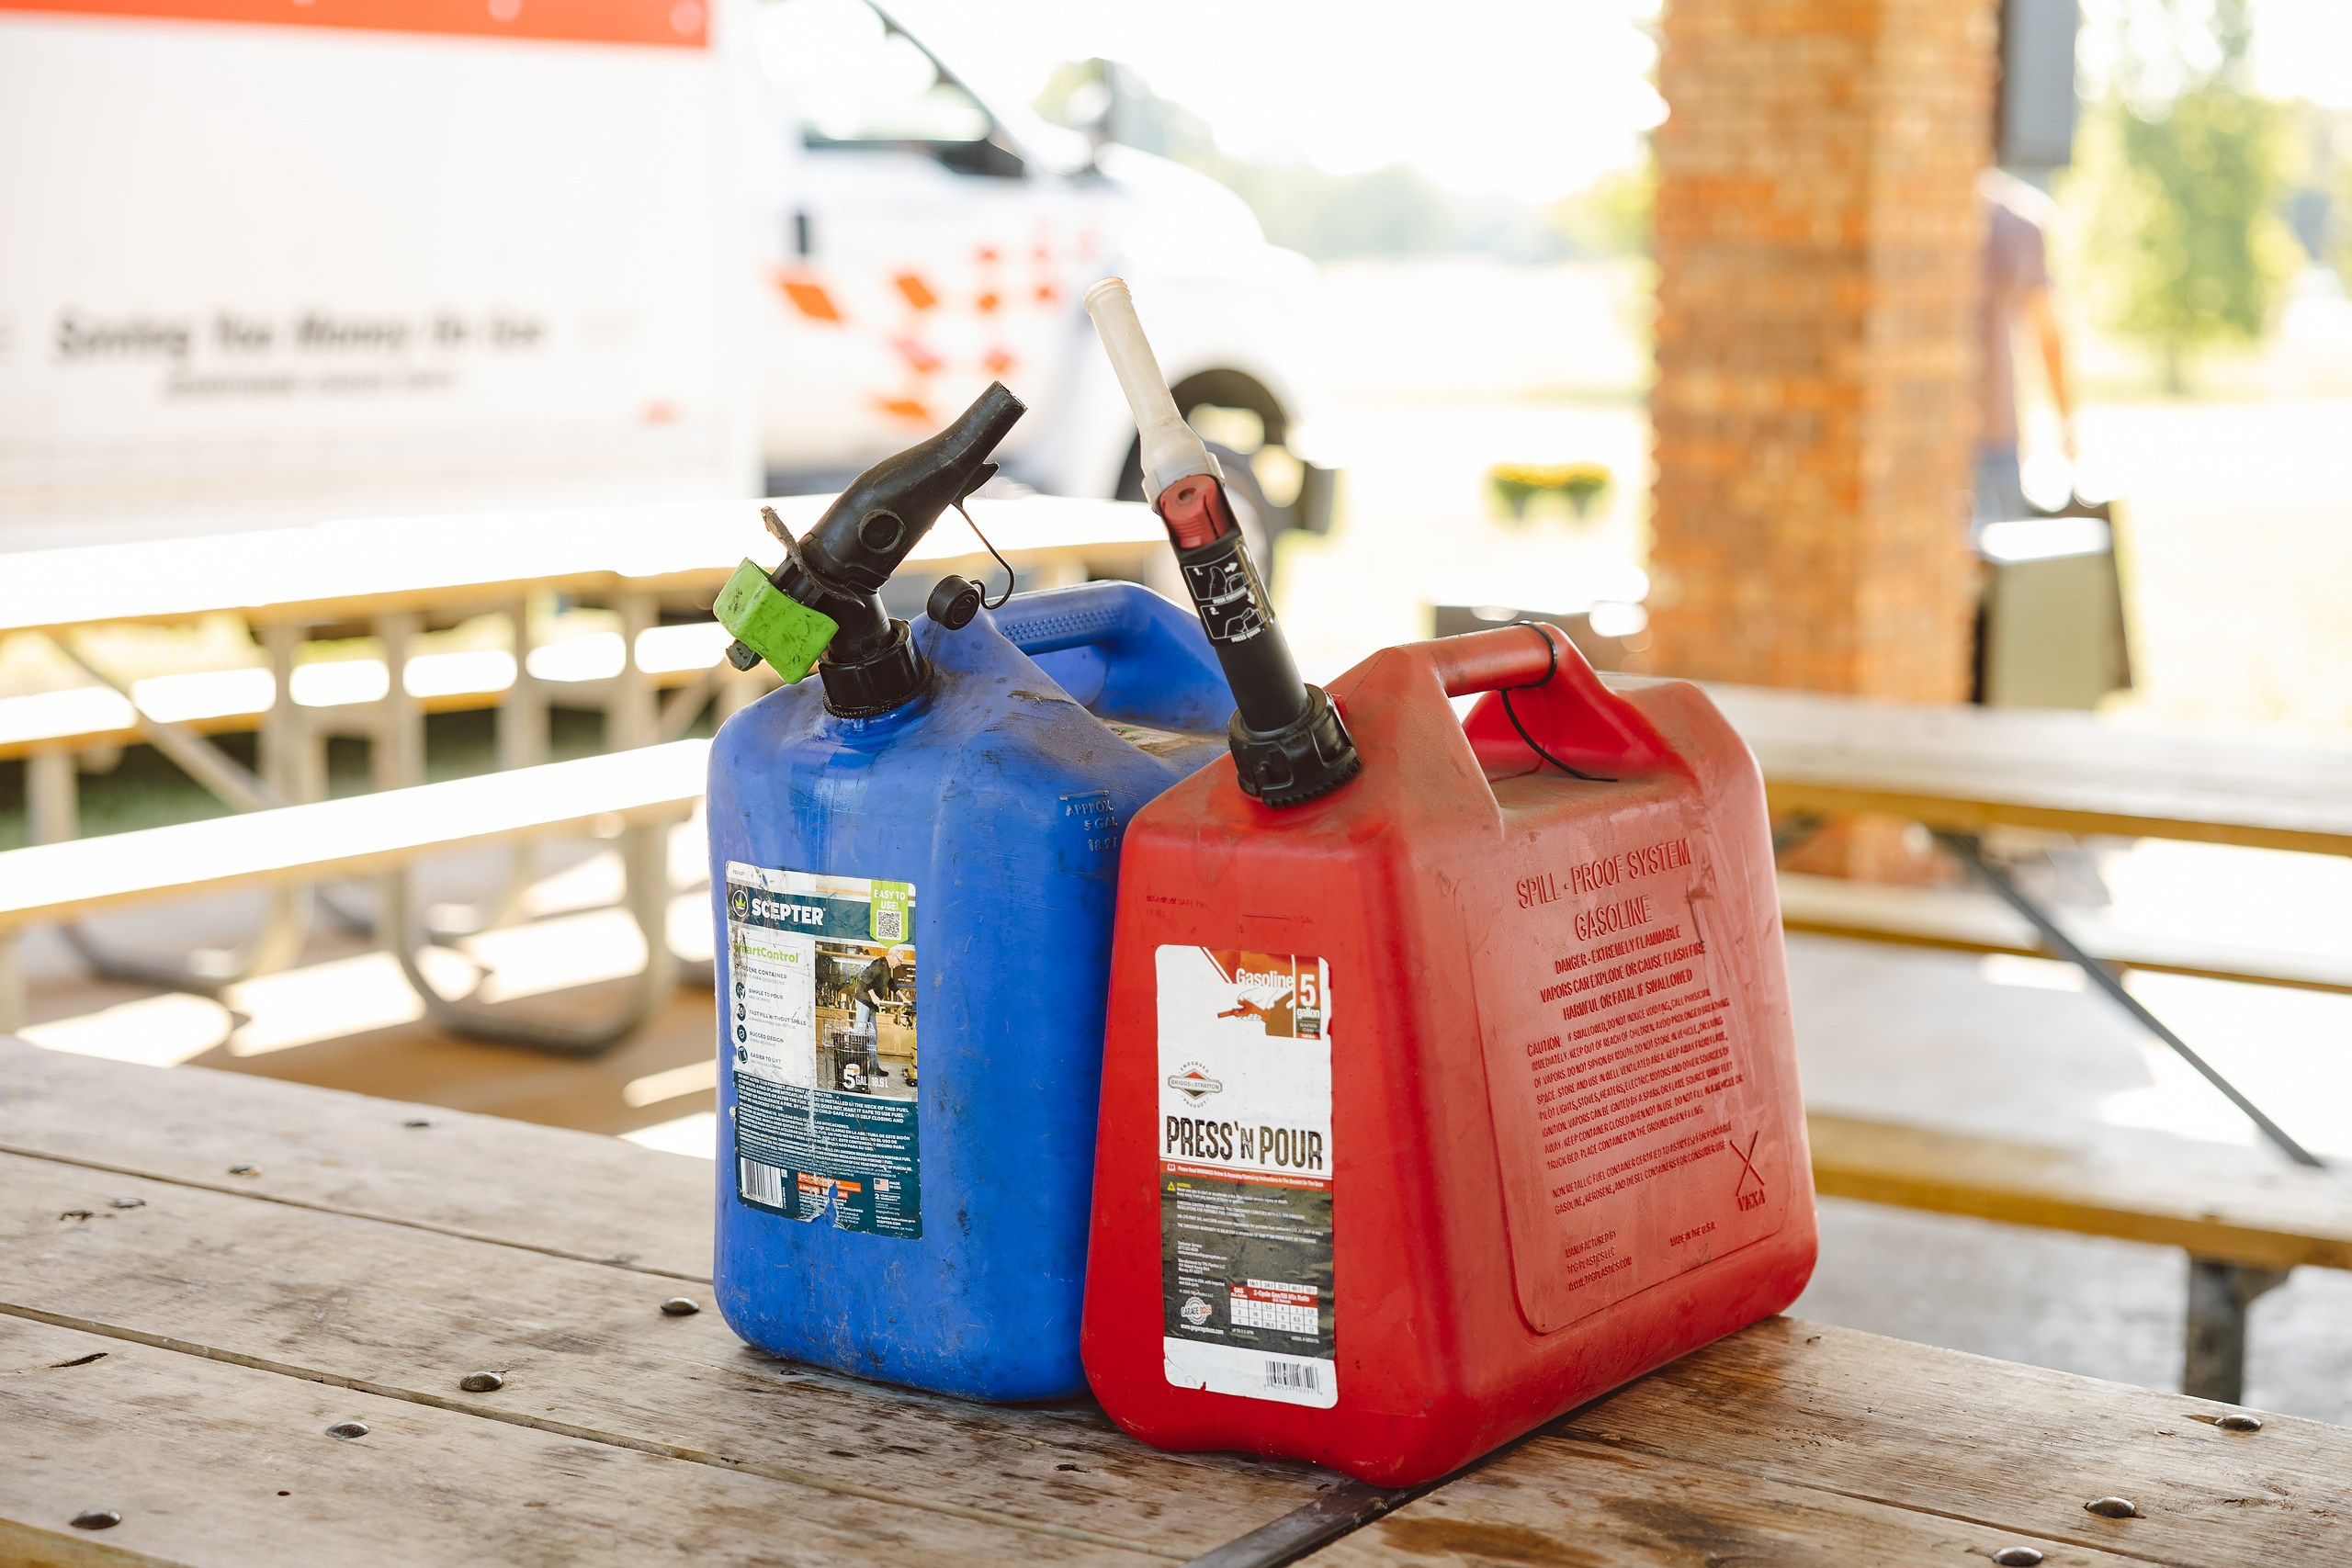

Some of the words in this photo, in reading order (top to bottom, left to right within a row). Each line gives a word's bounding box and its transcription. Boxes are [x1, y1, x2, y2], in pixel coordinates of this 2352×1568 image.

[1084, 819, 1091, 830] 5
[1516, 871, 1561, 908] SPILL
[1571, 854, 1625, 894] PROOF
[1626, 838, 1691, 879] SYSTEM
[875, 889, 894, 900] EASY
[896, 891, 906, 900] TO
[752, 898, 823, 926] SCEPTER
[880, 900, 899, 910] USE!
[1574, 895, 1652, 941] GASOLINE
[1555, 953, 1587, 974] DANGER
[1591, 939, 1635, 963] EXTREMELY
[1636, 925, 1681, 949] FLAMMABLE
[758, 969, 787, 979] CONTAINER
[1236, 968, 1294, 988] Gasoline
[1540, 981, 1572, 1002] VAPORS
[1573, 976, 1589, 992] CAN
[1590, 965, 1624, 987] EXPLODE
[1625, 962, 1637, 976] OR
[1637, 953, 1662, 972] CAUSE
[1664, 946, 1689, 964] FLASH
[1689, 941, 1705, 956] FIRE
[1300, 974, 1316, 1007] 5
[1563, 998, 1600, 1020] HARMFUL
[1600, 994, 1612, 1009] OR
[1612, 986, 1636, 1004] FATAL
[1637, 984, 1644, 996] IF
[1645, 968, 1692, 994] SWALLOWED
[1297, 1007, 1319, 1020] gallon
[842, 1069, 855, 1089] 5
[855, 1075, 867, 1085] GAL
[872, 1077, 884, 1088] 18.9
[820, 1109, 844, 1117] CHILD-SAFE
[1183, 1098, 1206, 1108] PRODUCT
[1260, 1126, 1322, 1170] POUR
